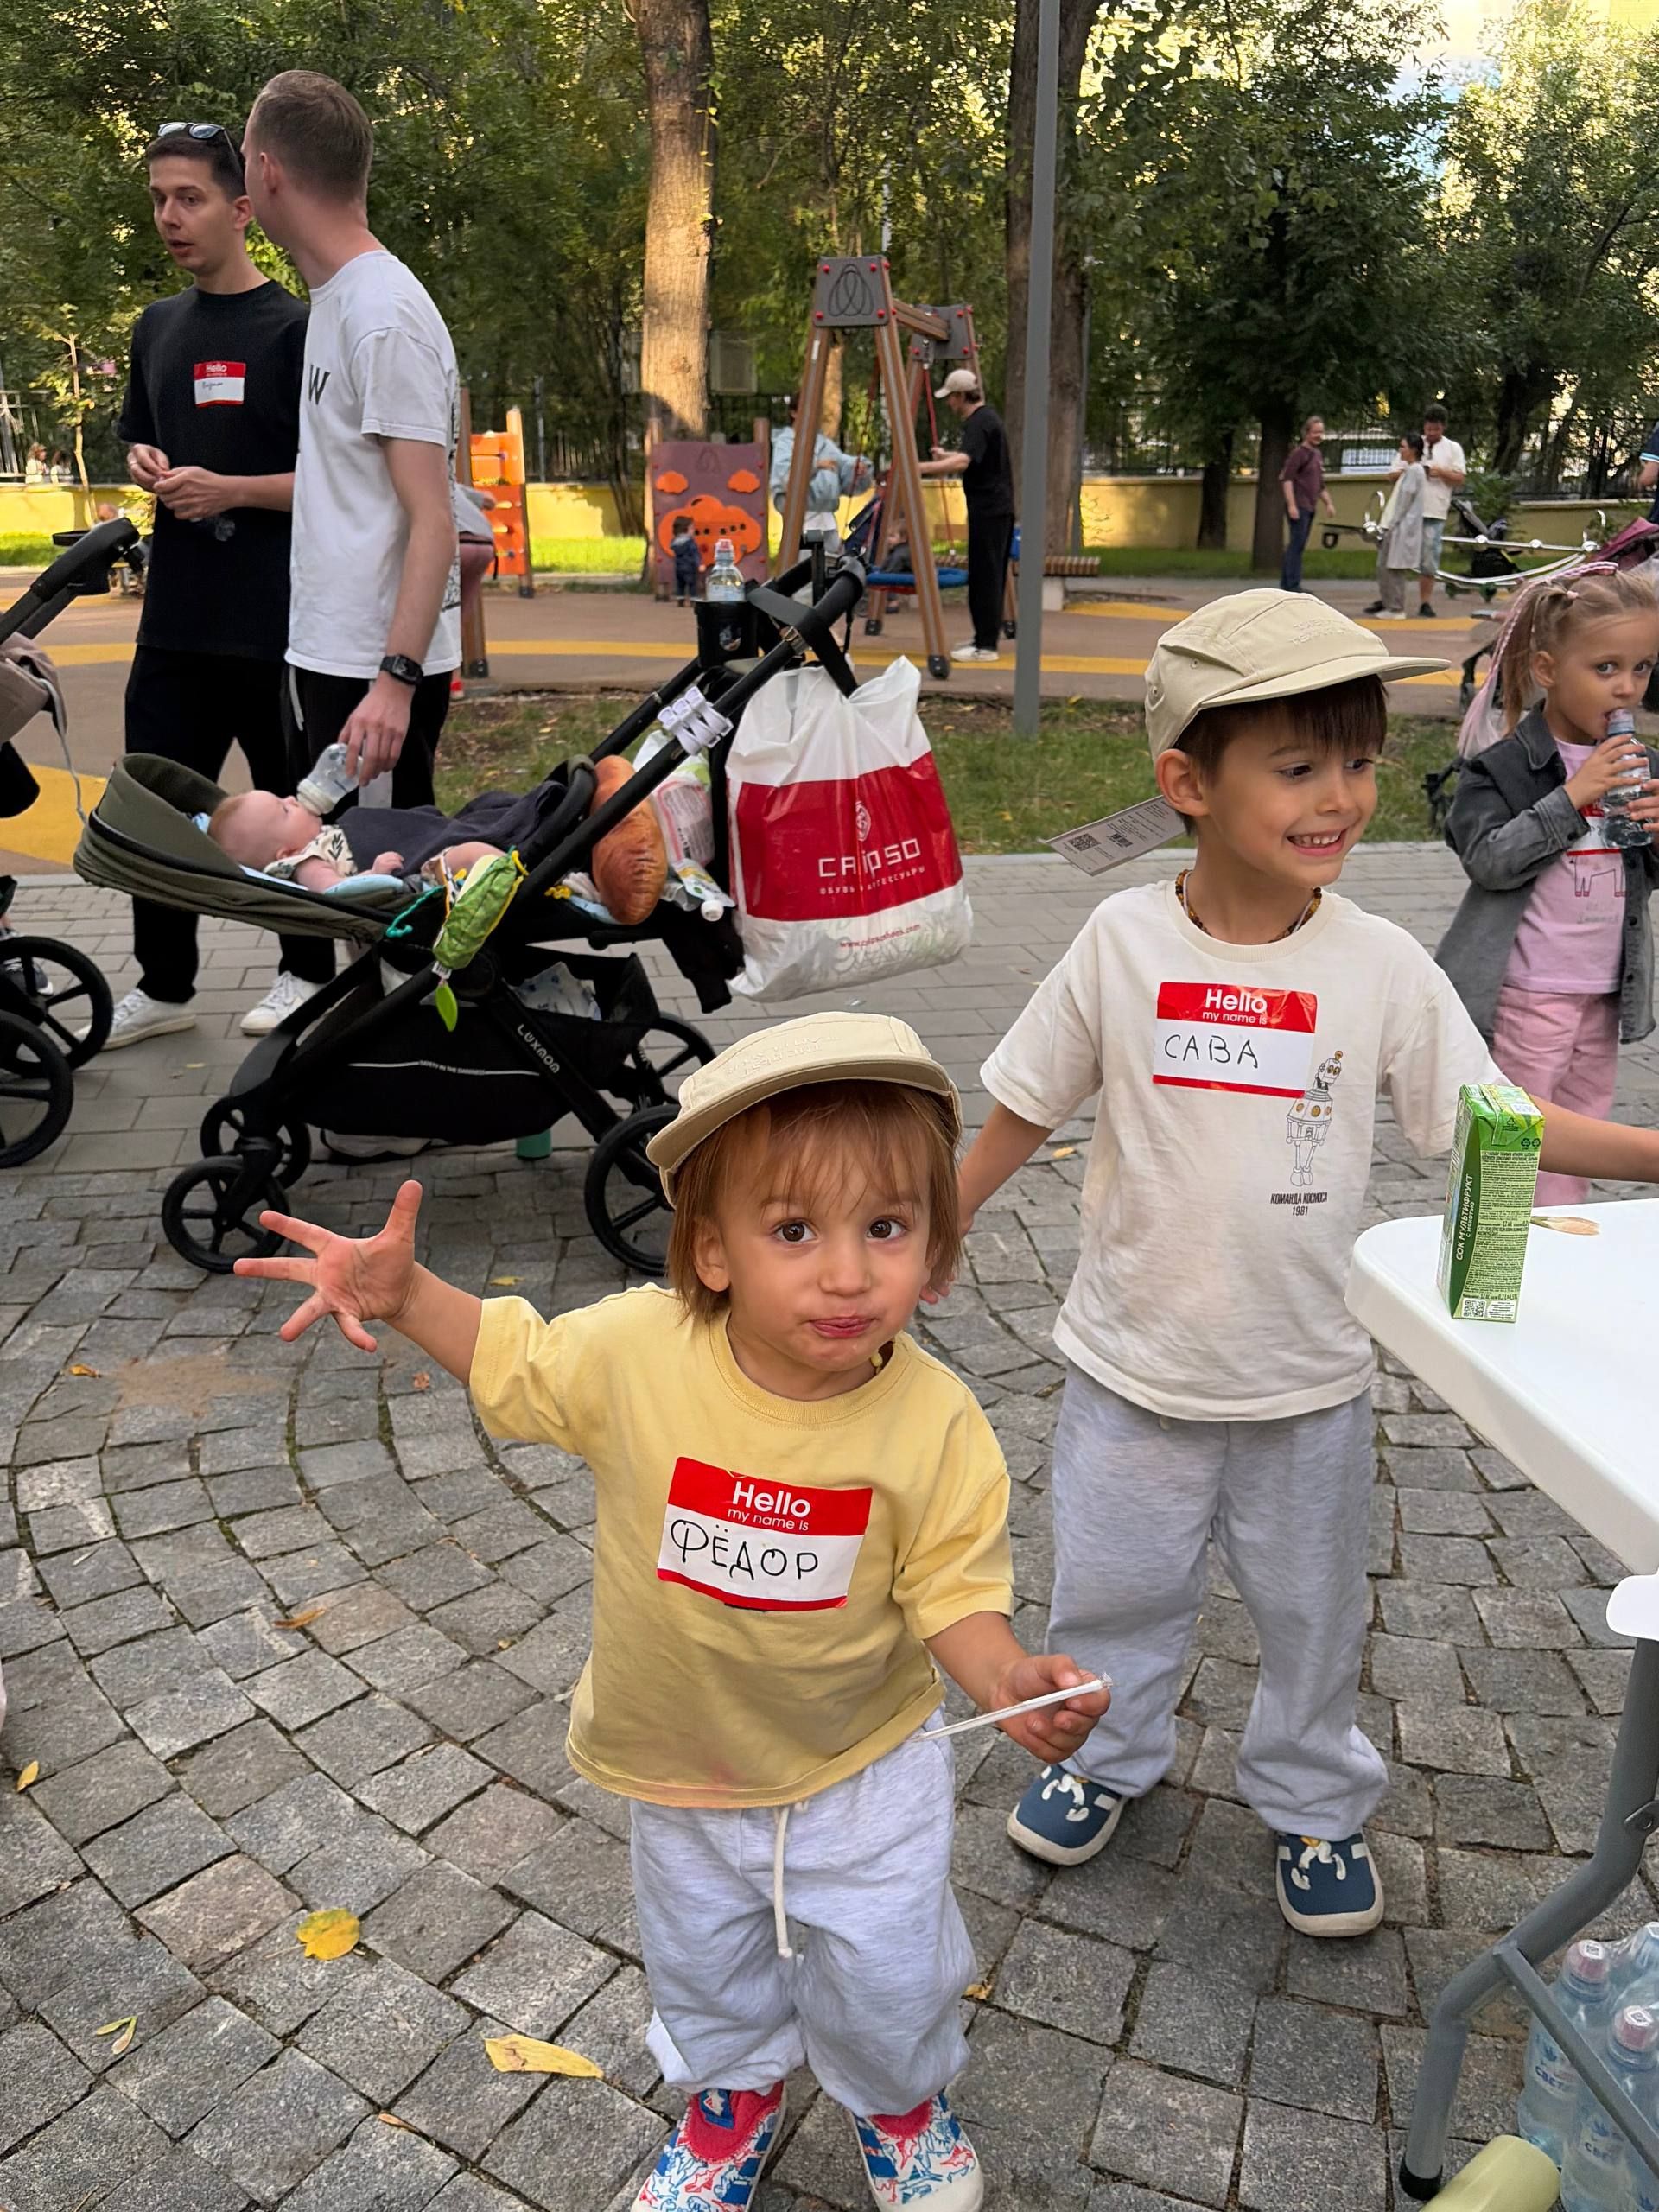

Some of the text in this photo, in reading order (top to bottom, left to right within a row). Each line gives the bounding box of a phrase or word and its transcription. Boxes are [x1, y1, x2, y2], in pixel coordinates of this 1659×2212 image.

[207, 362, 227, 372] Hello
[819, 886, 855, 895] ОБУВЬ
[1205, 988, 1268, 1014] Hello
[1202, 1011, 1268, 1025] my name is
[1164, 1034, 1258, 1069] САВА
[1270, 1192, 1328, 1205] КОМАНДА КОСМОСА
[1459, 1173, 1473, 1241] МУЛЬТИФРУКТ
[1293, 1205, 1309, 1217] 1981
[1456, 1242, 1465, 1261] СОК
[732, 1481, 811, 1518] Hello
[727, 1508, 809, 1531] my name is
[671, 1519, 819, 1581] ФЁДОР
